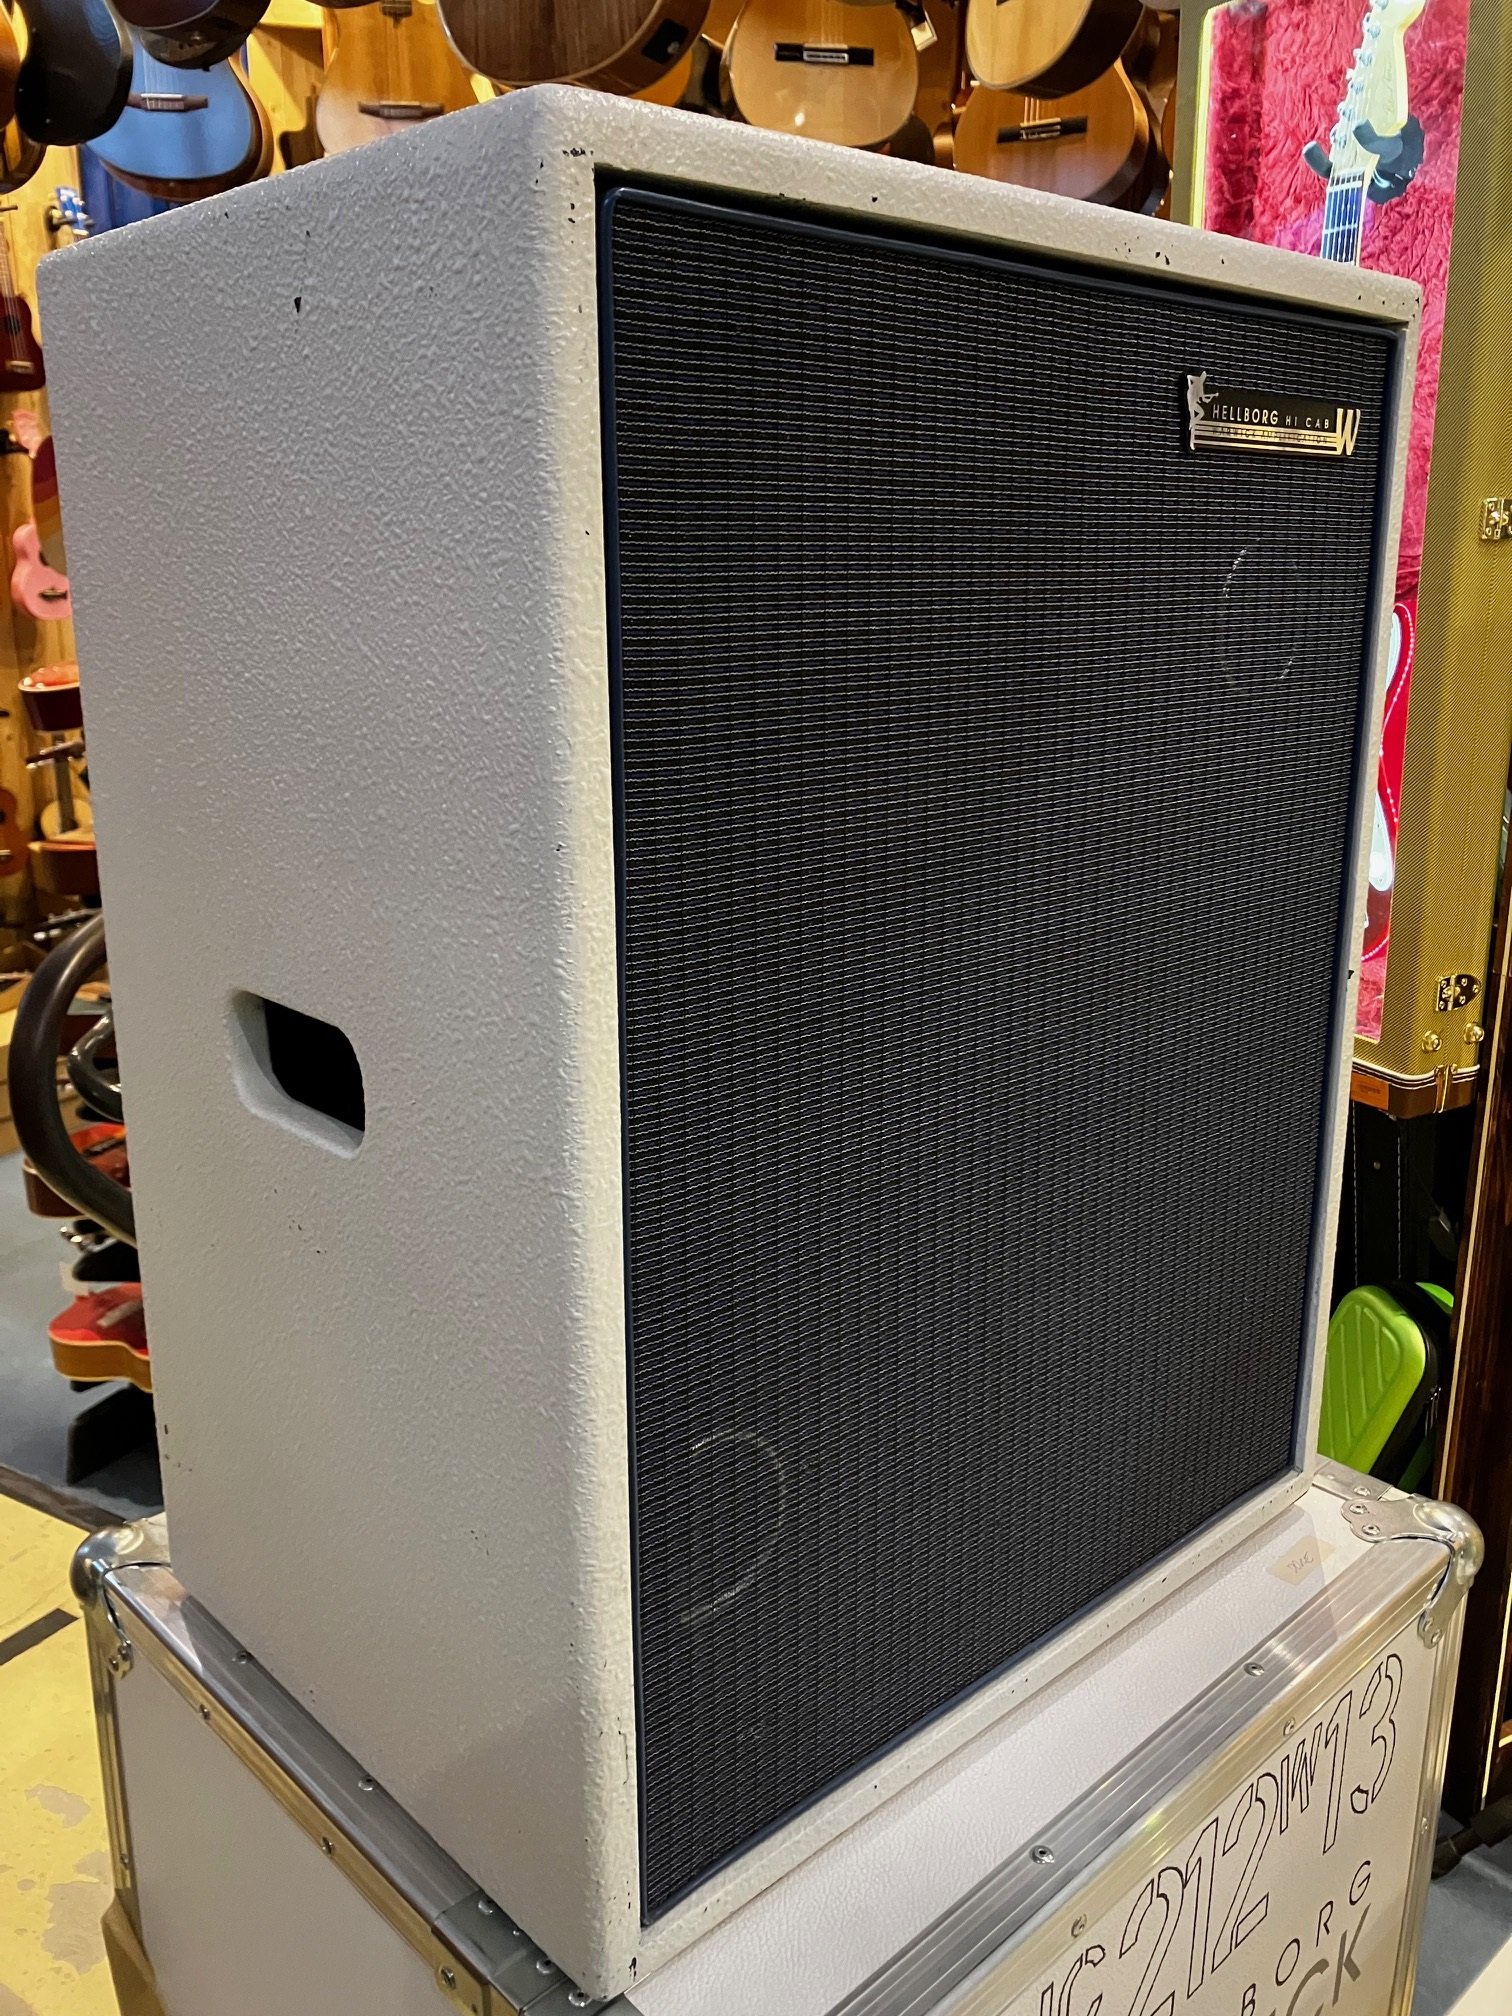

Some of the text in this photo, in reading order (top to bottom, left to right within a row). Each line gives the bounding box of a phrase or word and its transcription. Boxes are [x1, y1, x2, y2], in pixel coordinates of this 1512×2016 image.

[1212, 404, 1329, 429] HELLBORG HI CAB
[1268, 1903, 1371, 2016] CK
